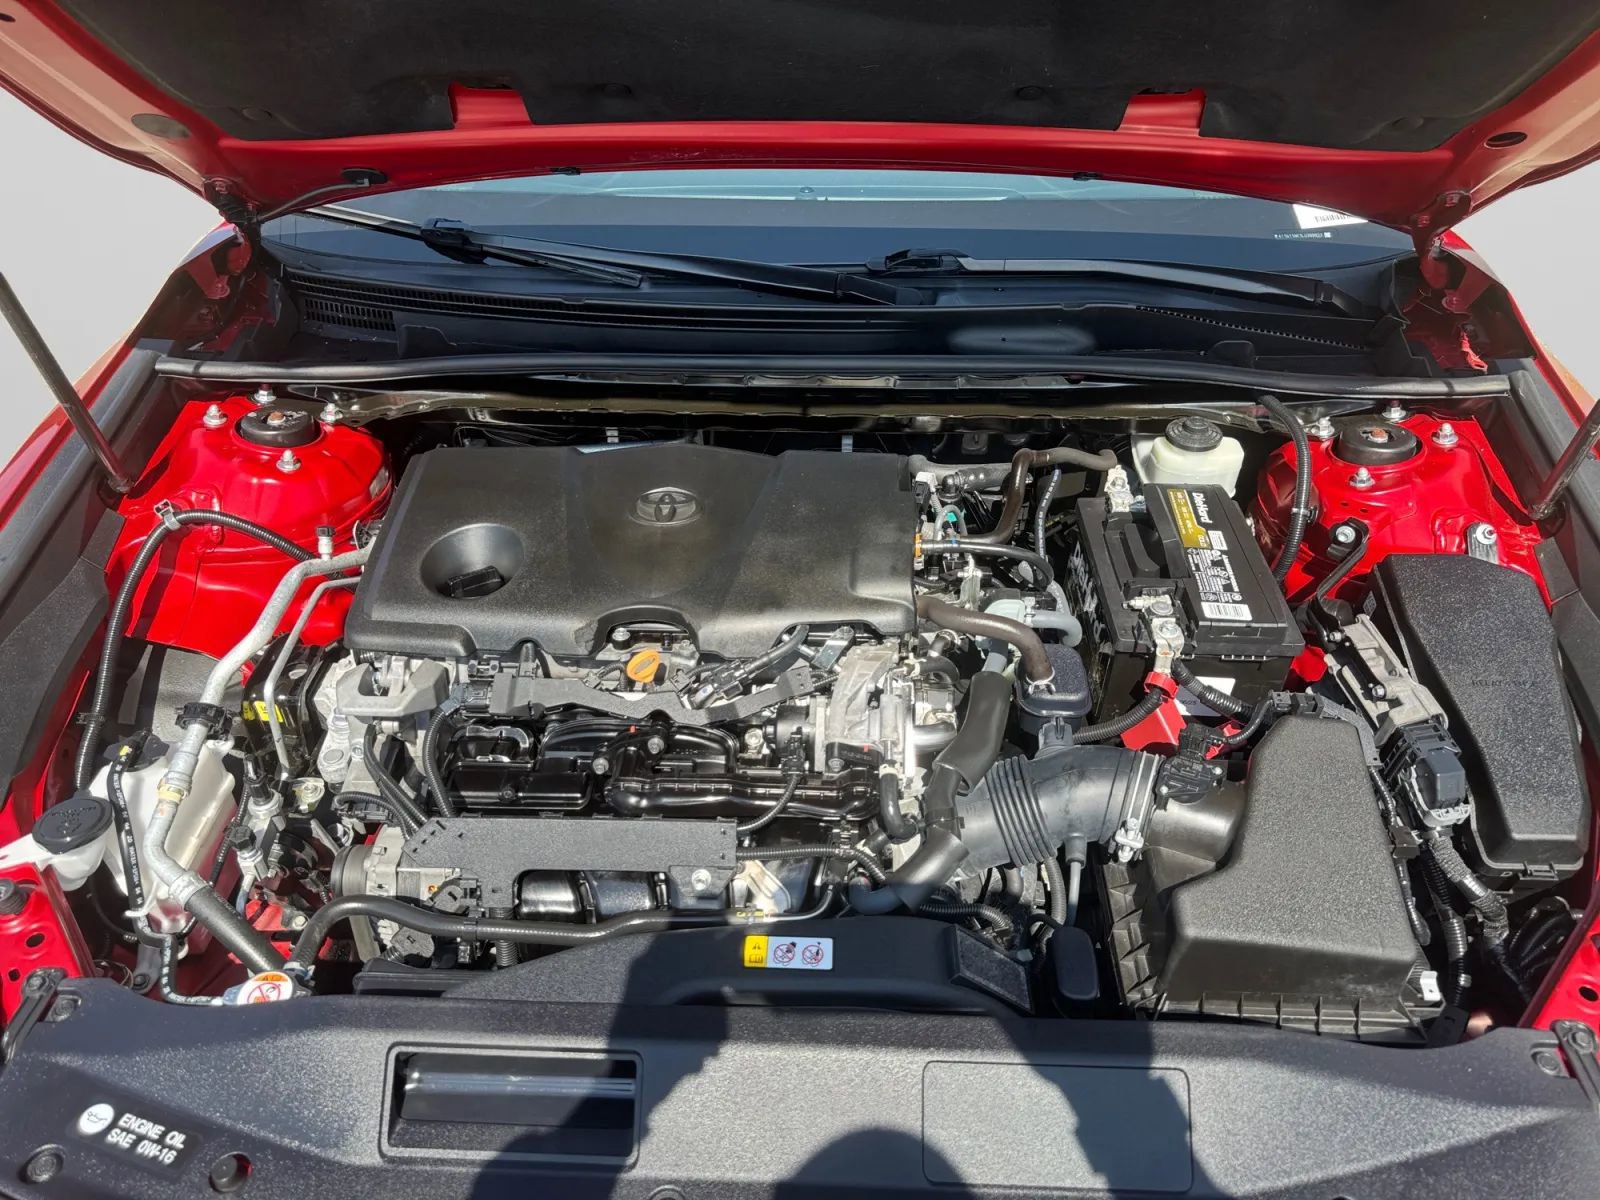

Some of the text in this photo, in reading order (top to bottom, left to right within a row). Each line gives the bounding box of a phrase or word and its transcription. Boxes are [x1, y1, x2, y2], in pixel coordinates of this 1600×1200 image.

[1192, 492, 1213, 523] DieHard
[106, 1128, 177, 1165] SAE 0W-16
[118, 1113, 186, 1149] ENGINE OIL
